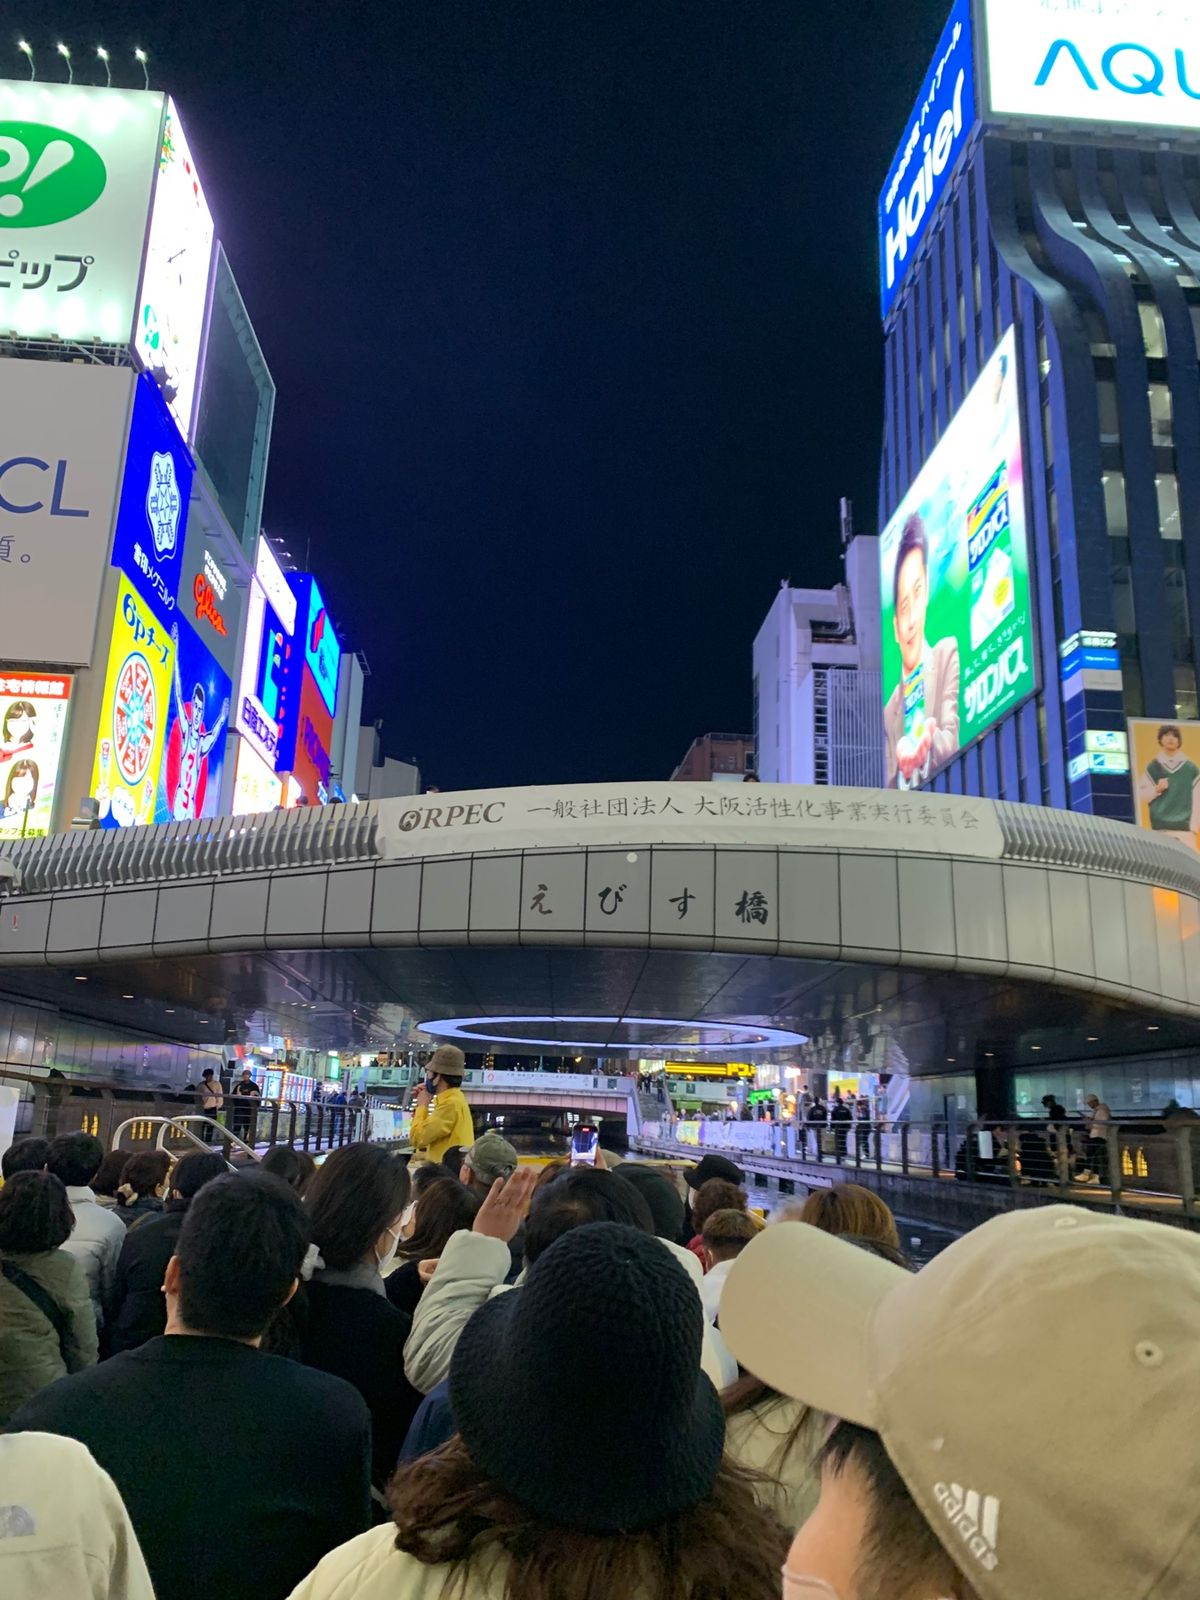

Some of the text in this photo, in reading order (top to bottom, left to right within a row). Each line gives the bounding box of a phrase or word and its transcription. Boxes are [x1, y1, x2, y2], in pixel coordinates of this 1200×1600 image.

[886, 68, 965, 288] Haier
[0, 456, 90, 518] CL
[193, 573, 228, 636] Glico
[964, 636, 1029, 723] サロンパス
[398, 796, 980, 832] ORPEC 一般社団法人 大阪活性化事業実行委員会
[530, 884, 769, 926] えびす橋
[934, 1482, 998, 1571] adidas
